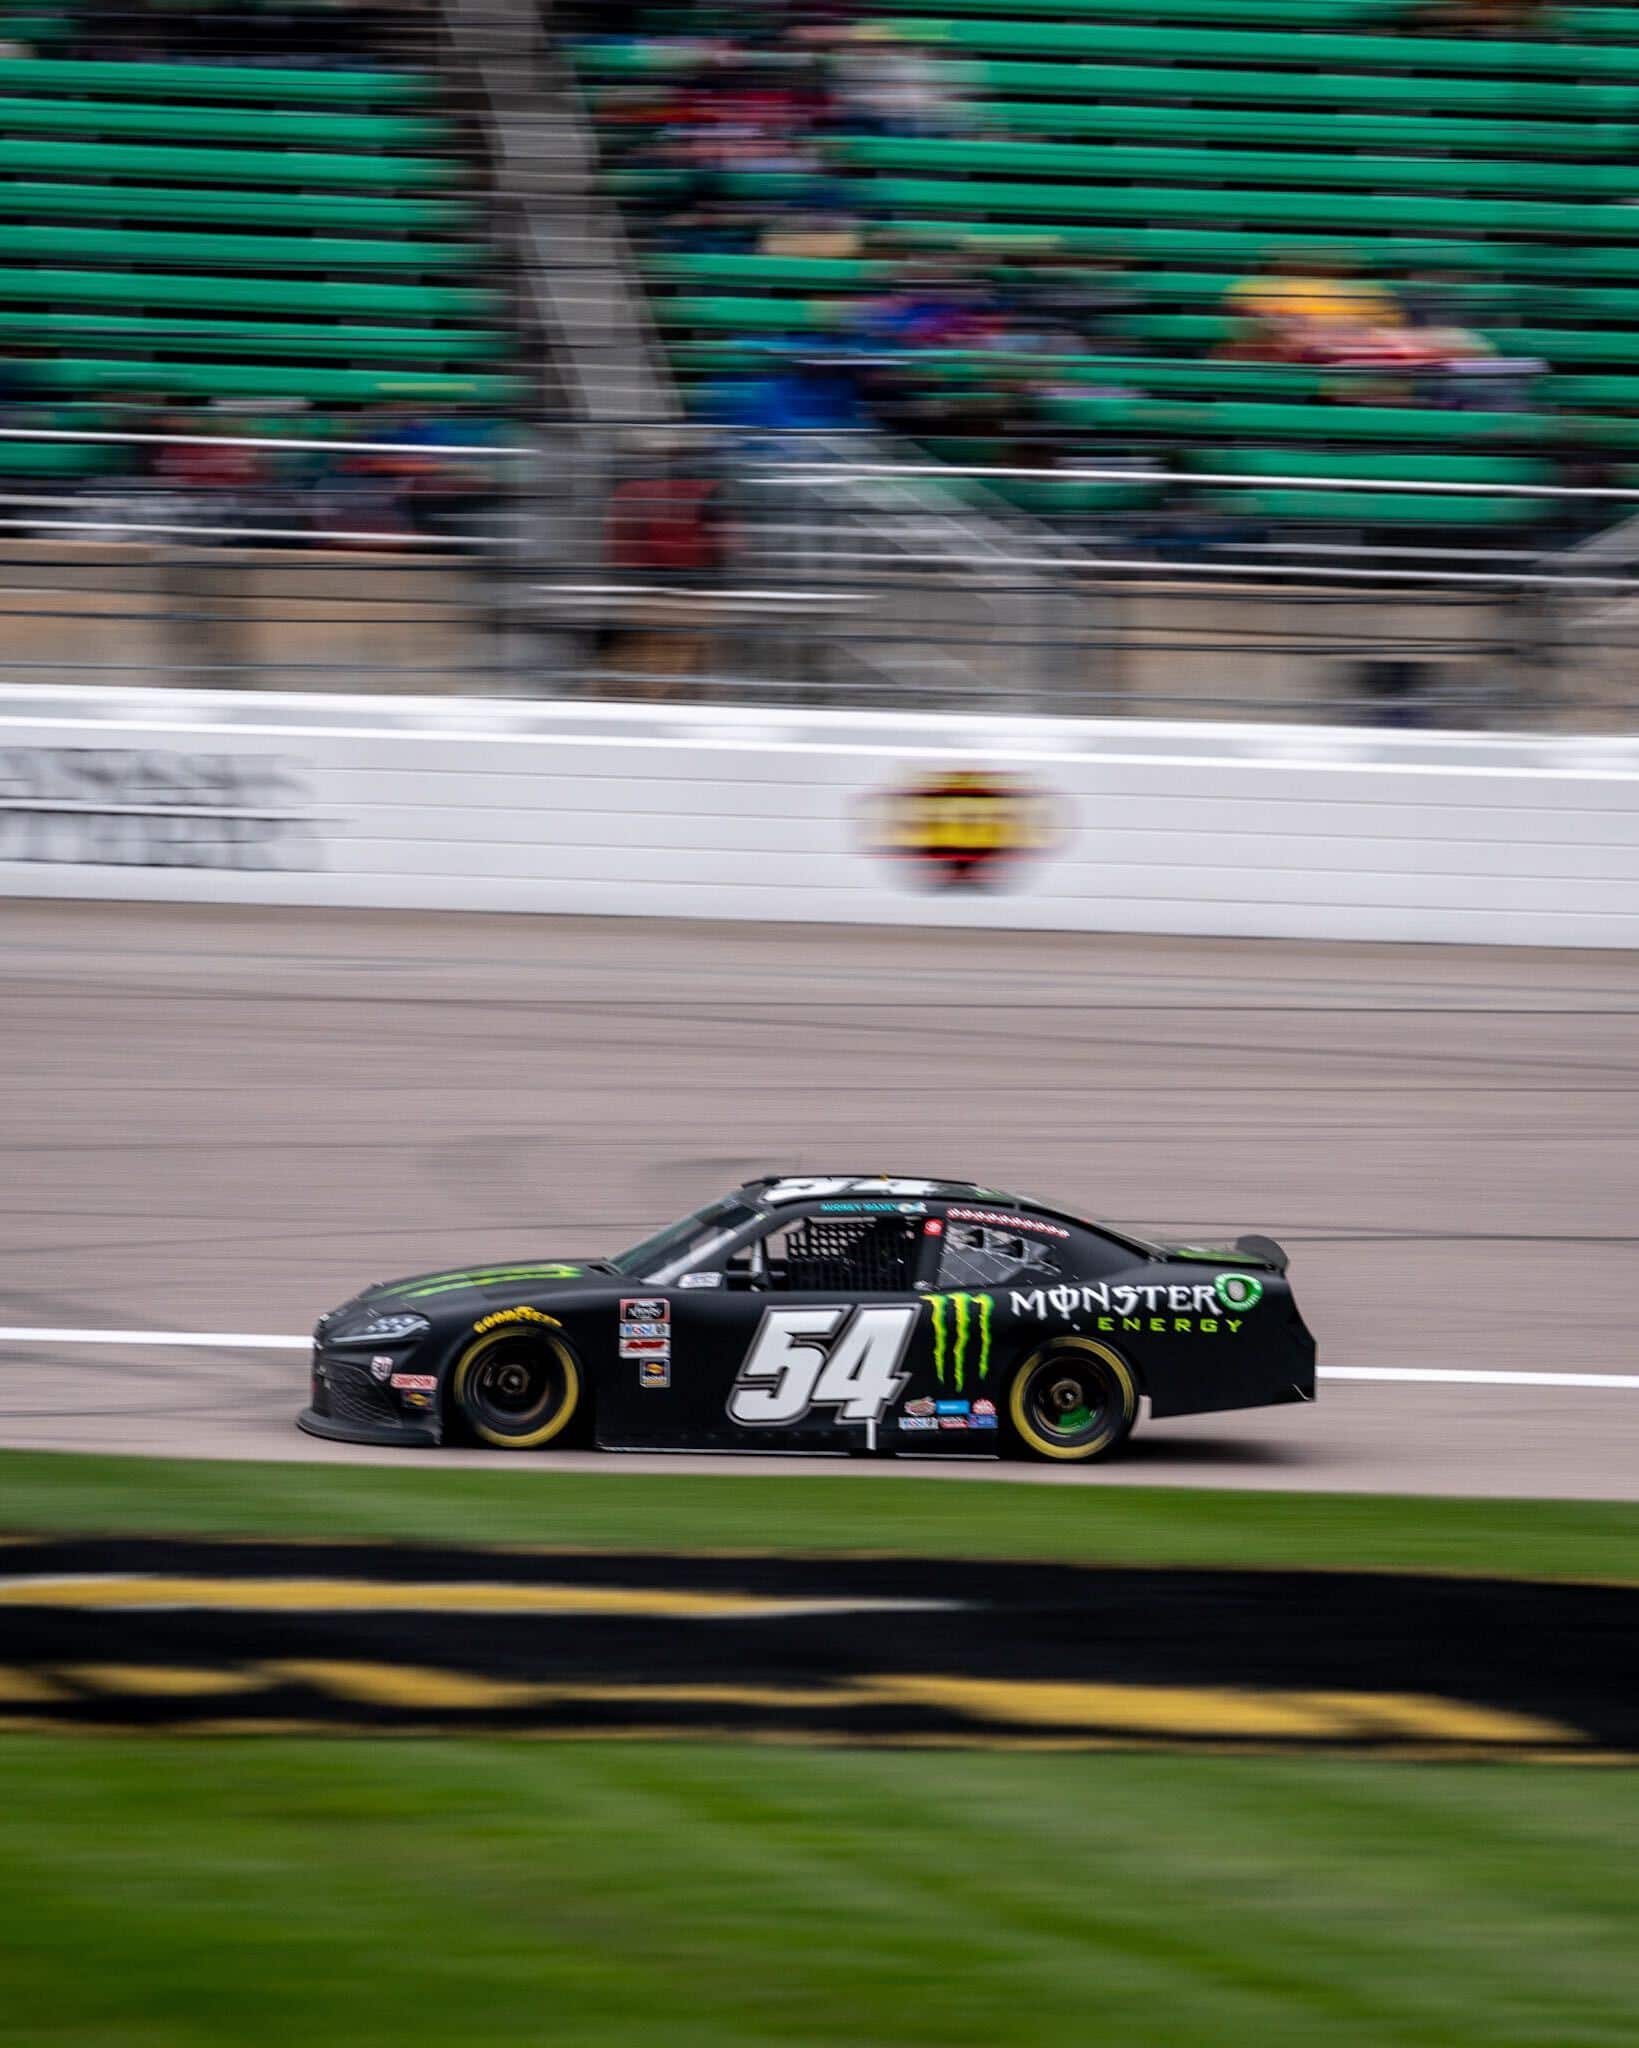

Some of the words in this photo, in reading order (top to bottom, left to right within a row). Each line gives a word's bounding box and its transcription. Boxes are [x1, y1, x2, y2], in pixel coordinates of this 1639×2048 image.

[1009, 1282, 1223, 1320] MONSTER
[1098, 1317, 1243, 1333] ENERGY
[726, 1304, 921, 1426] 54
